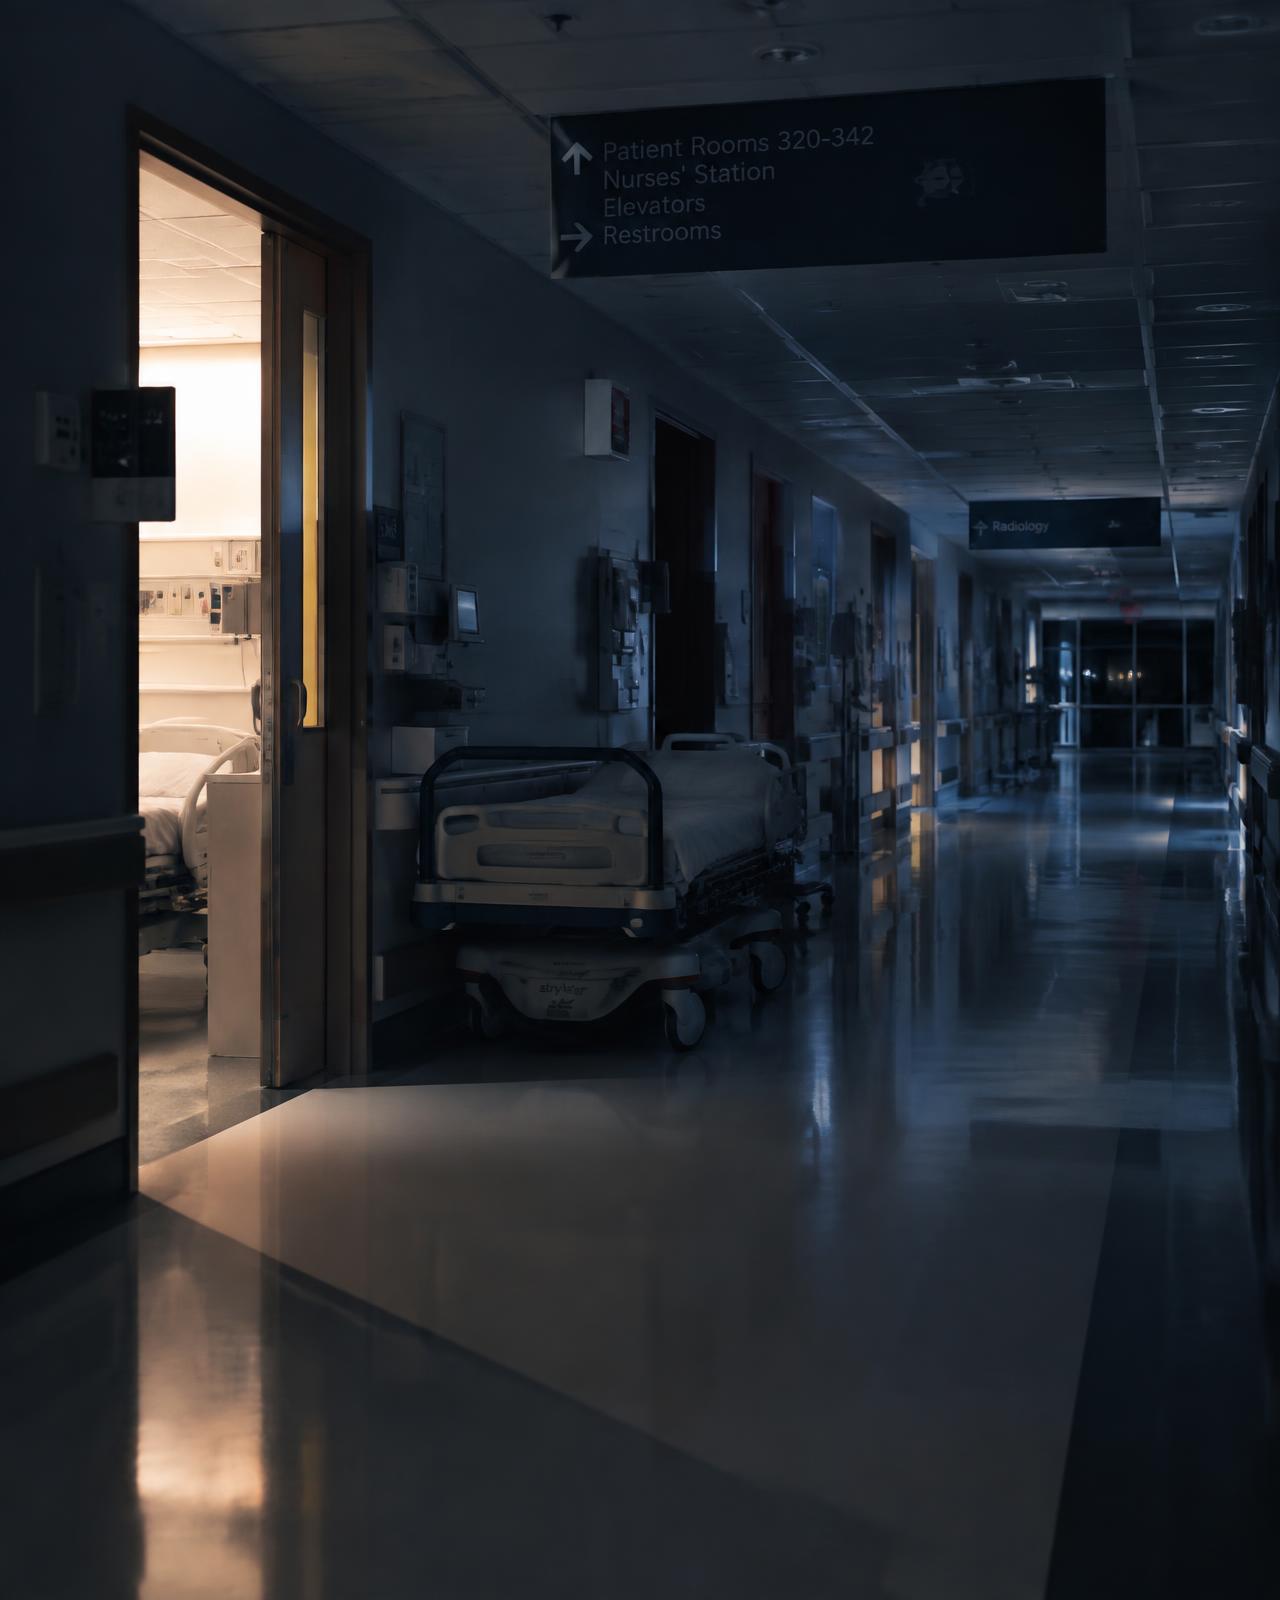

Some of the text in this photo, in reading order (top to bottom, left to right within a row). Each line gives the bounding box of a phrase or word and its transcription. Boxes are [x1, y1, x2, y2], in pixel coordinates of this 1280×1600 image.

[603, 125, 875, 162] Patient Rooms 320-342
[603, 161, 776, 190] Nurses' Station
[603, 196, 706, 218] Elevators
[603, 223, 722, 245] Restrooms
[992, 519, 1049, 535] Radiology
